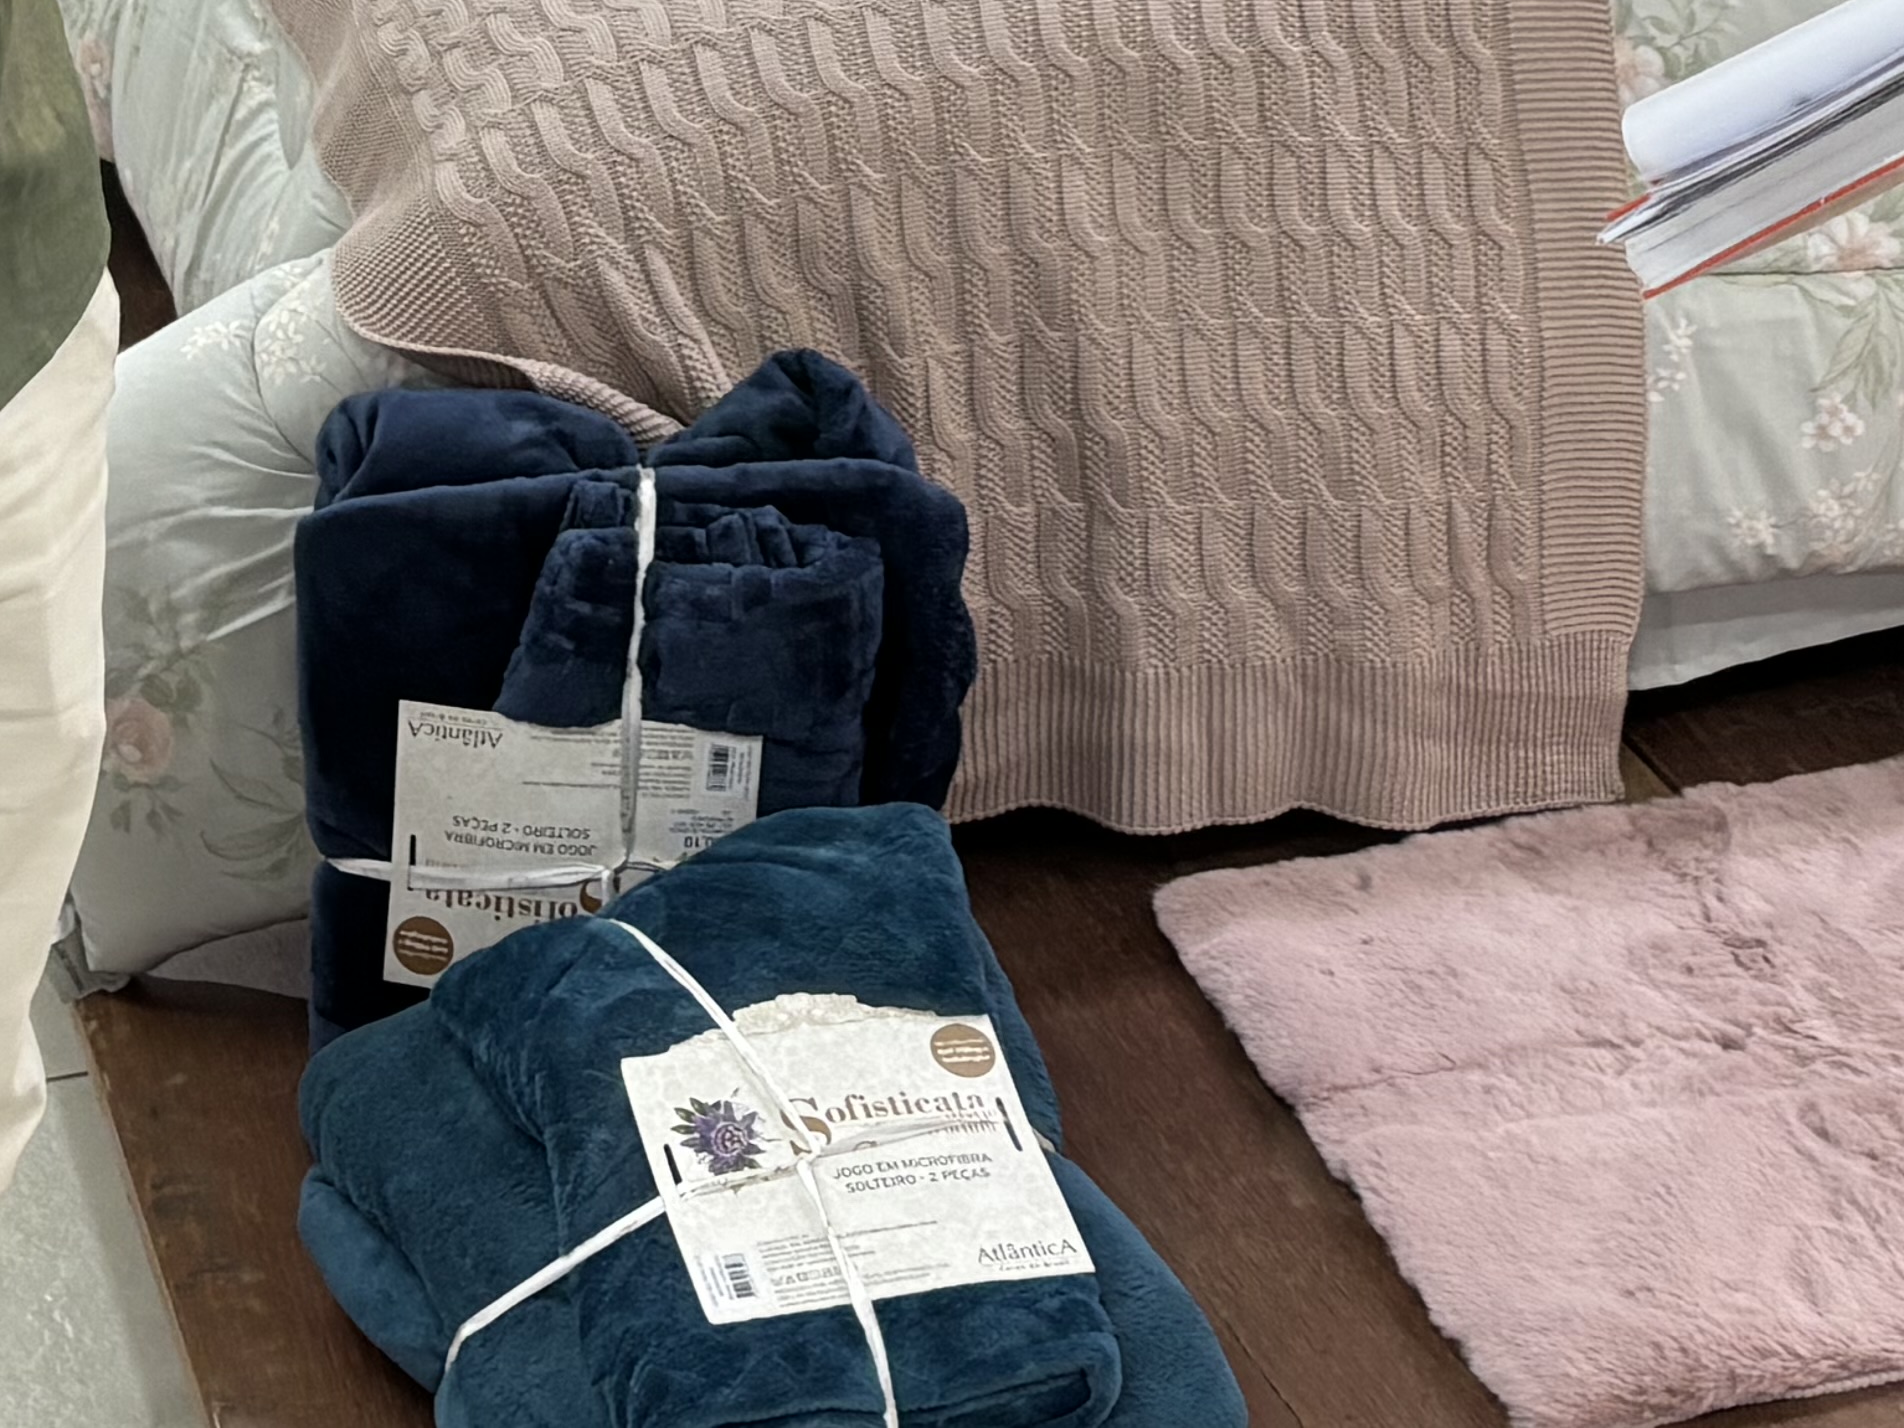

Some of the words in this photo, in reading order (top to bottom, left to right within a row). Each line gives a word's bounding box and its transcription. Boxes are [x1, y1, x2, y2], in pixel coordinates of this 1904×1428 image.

[407, 719, 504, 749] AtlânticA
[452, 814, 498, 831] PEÇAS
[502, 822, 512, 834] 2
[523, 824, 591, 840] SOLTEIRO
[443, 830, 530, 853] MICROFIBRA
[533, 841, 554, 855] EM
[558, 844, 598, 857] JOGO
[832, 1162, 873, 1180] JOGO
[875, 1160, 899, 1174] EM
[900, 1152, 993, 1170] MICROFIBRA
[845, 1173, 917, 1194] SOLTEIRO
[929, 1171, 938, 1183] 2
[942, 1166, 991, 1183] PEÇAS
[977, 1238, 1079, 1266] AtlânticA
